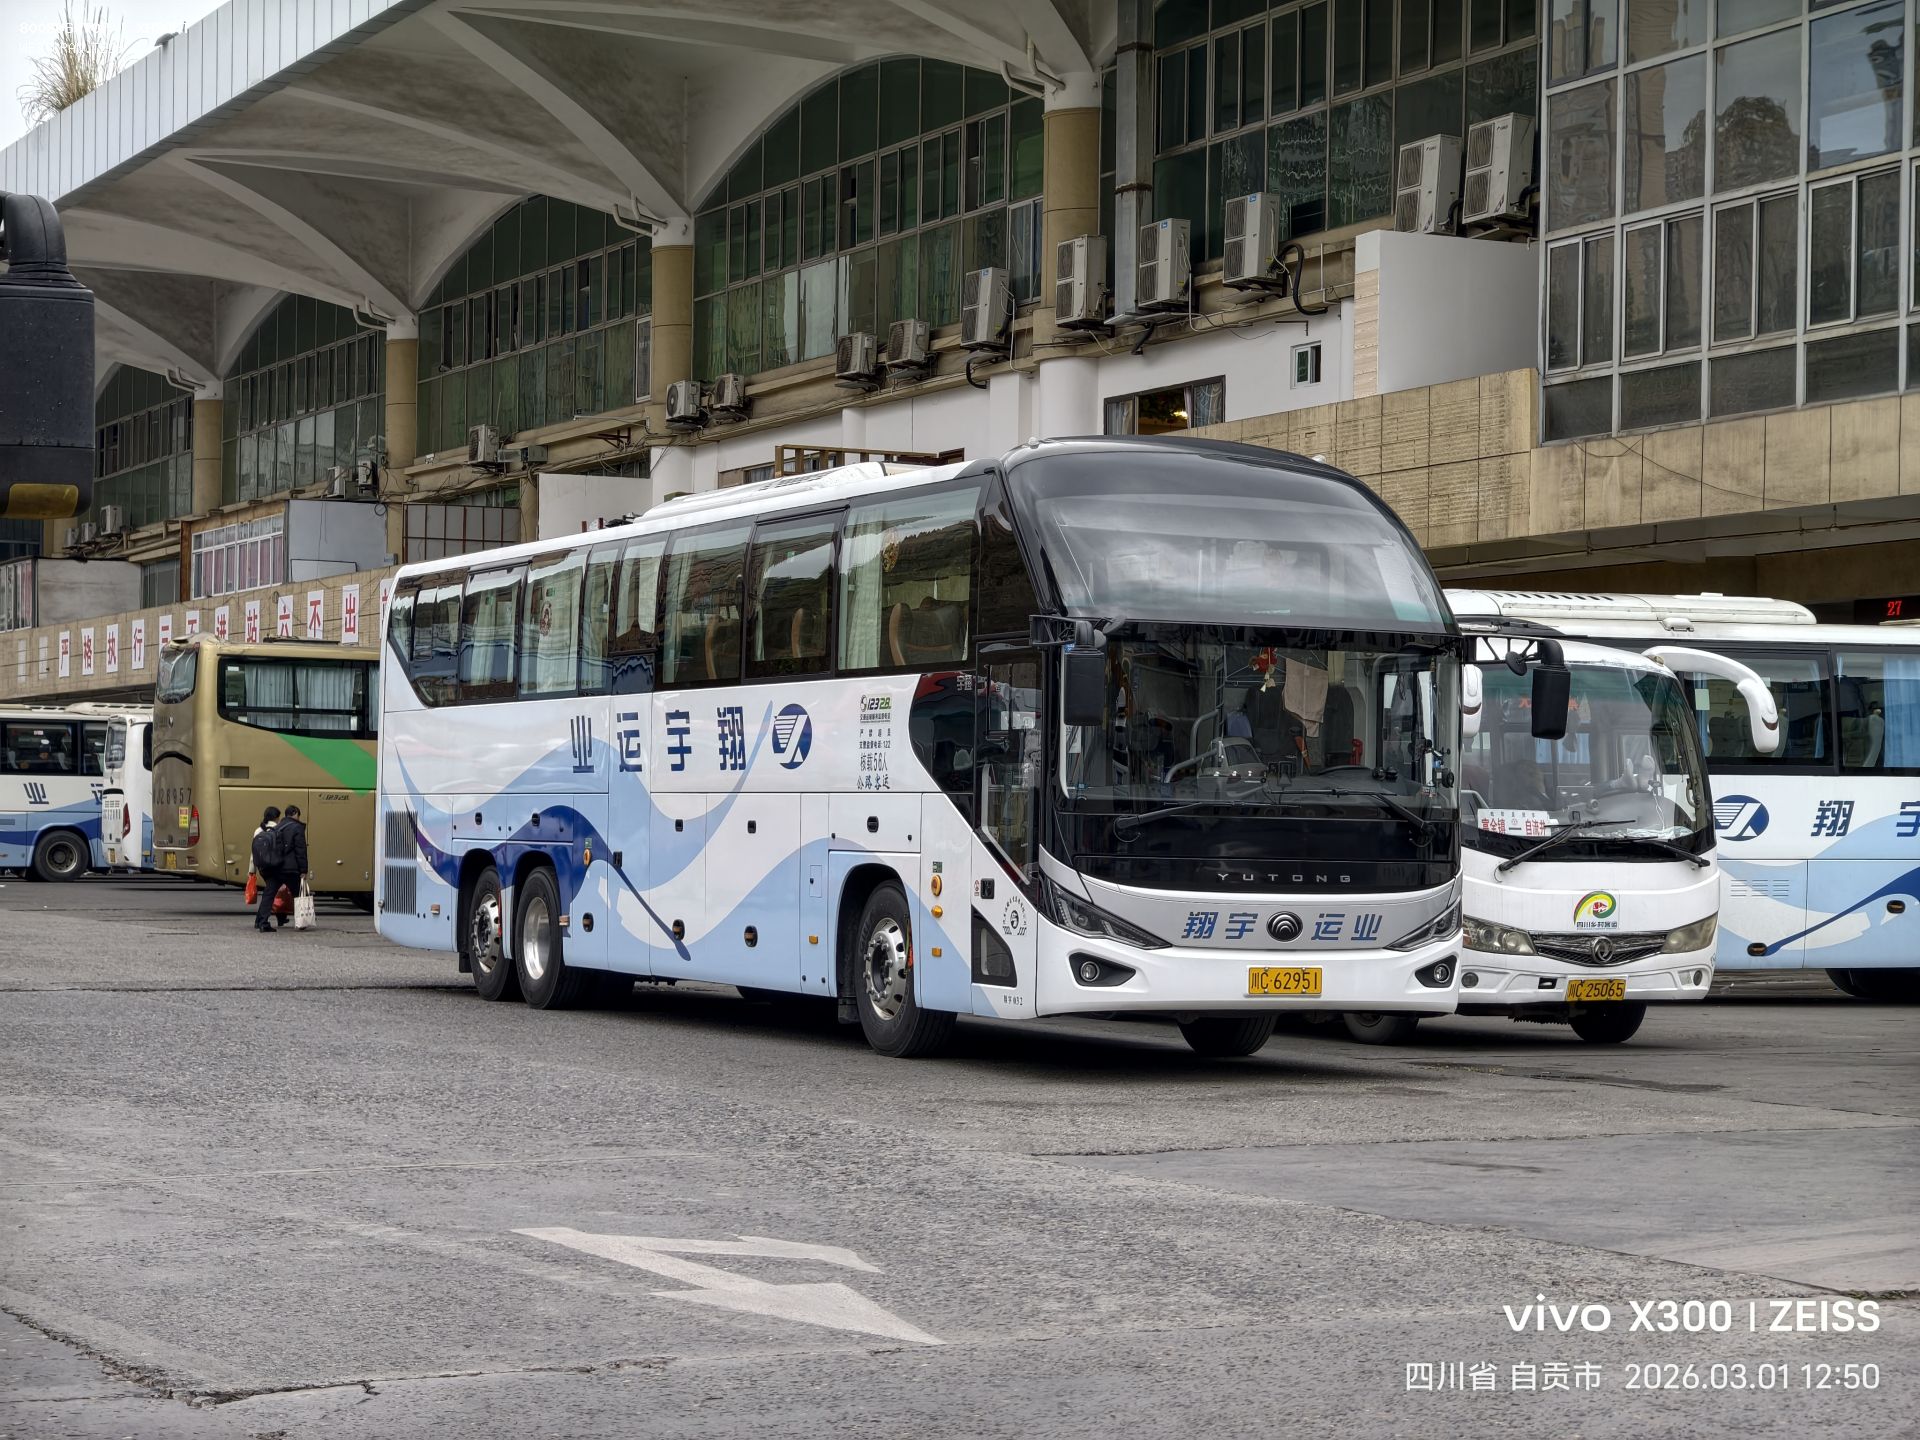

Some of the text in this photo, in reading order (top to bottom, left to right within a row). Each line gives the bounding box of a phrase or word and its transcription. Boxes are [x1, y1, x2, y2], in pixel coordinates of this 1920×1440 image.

[1887, 600, 1902, 616] 27
[861, 752, 887, 771] 核载56人
[857, 774, 890, 790] 公路客运
[1218, 873, 1351, 883] YUTONG
[1181, 911, 1382, 941] 翔宇 运业
